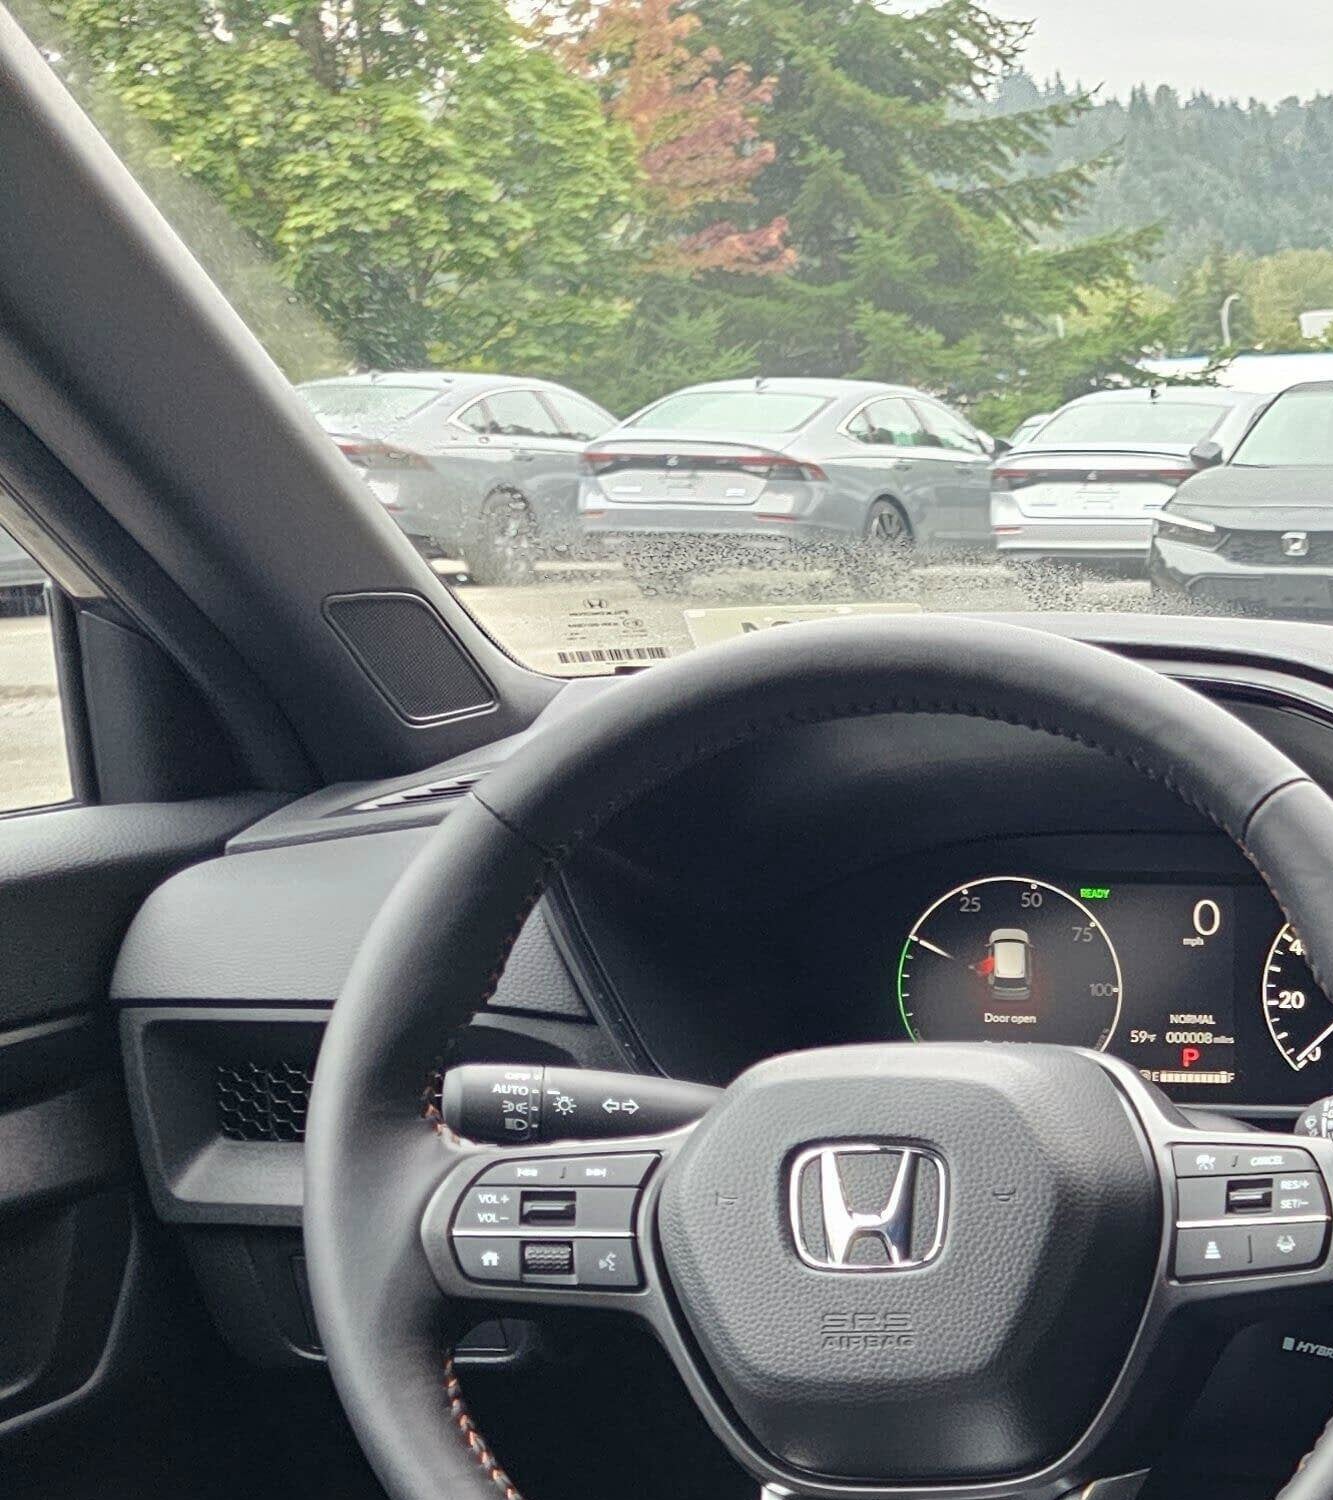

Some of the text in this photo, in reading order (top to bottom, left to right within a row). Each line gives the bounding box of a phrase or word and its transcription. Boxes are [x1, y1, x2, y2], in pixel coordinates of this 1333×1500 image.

[1021, 892, 1043, 908] 50
[1080, 888, 1110, 899] READY
[959, 897, 981, 912] 25
[1193, 900, 1221, 937] 0
[1072, 927, 1093, 942] 75
[1089, 983, 1113, 997] 100
[1279, 991, 1305, 1009] 20
[984, 1012, 1037, 1025] Door open
[1169, 1014, 1216, 1025] NORMAL
[1182, 1048, 1200, 1067] P
[1152, 1071, 1160, 1082] E
[492, 1083, 529, 1096] AUTO
[1250, 1156, 1285, 1167] CANCEL
